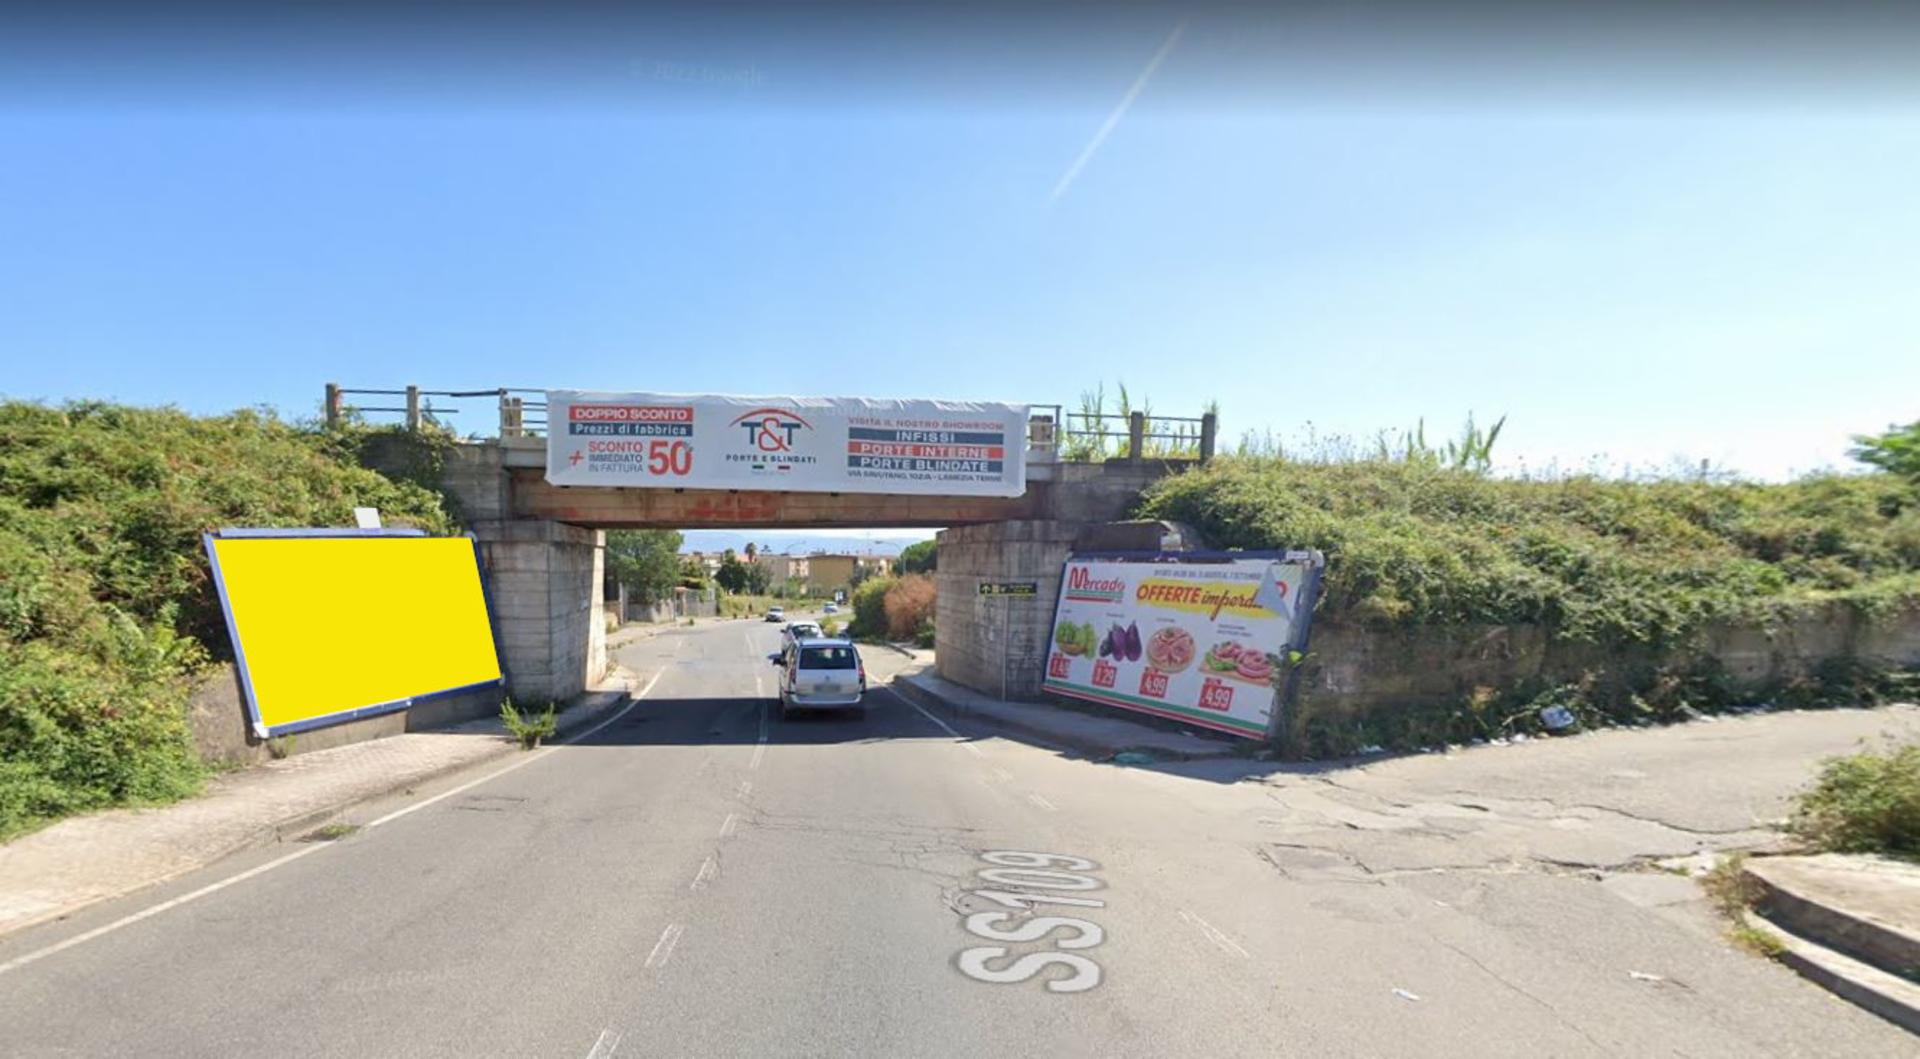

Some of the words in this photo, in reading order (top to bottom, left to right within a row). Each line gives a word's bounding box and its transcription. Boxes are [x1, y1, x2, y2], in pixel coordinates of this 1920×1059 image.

[575, 408, 627, 419] DOPPIO
[630, 409, 688, 420] SCONTO
[849, 416, 881, 426] VISITA
[896, 419, 940, 429] NOSTRO
[575, 424, 614, 433] Prezzi
[619, 424, 630, 433] di
[635, 425, 687, 435] fabbrica
[741, 417, 801, 452] T&T
[896, 431, 955, 443] INFISSI
[588, 441, 643, 453] SCONTO
[861, 443, 913, 455] PORTE
[920, 446, 989, 459] INTERNE
[588, 454, 643, 463] IMMEDIATO
[726, 454, 758, 462] PORTE
[588, 464, 599, 472] IN
[601, 464, 643, 473] FATTURA
[860, 457, 913, 470] PORTE
[916, 460, 989, 472] BLINDATE
[1068, 566, 1125, 592] Mercado
[1136, 584, 1201, 605] OFFERTE
